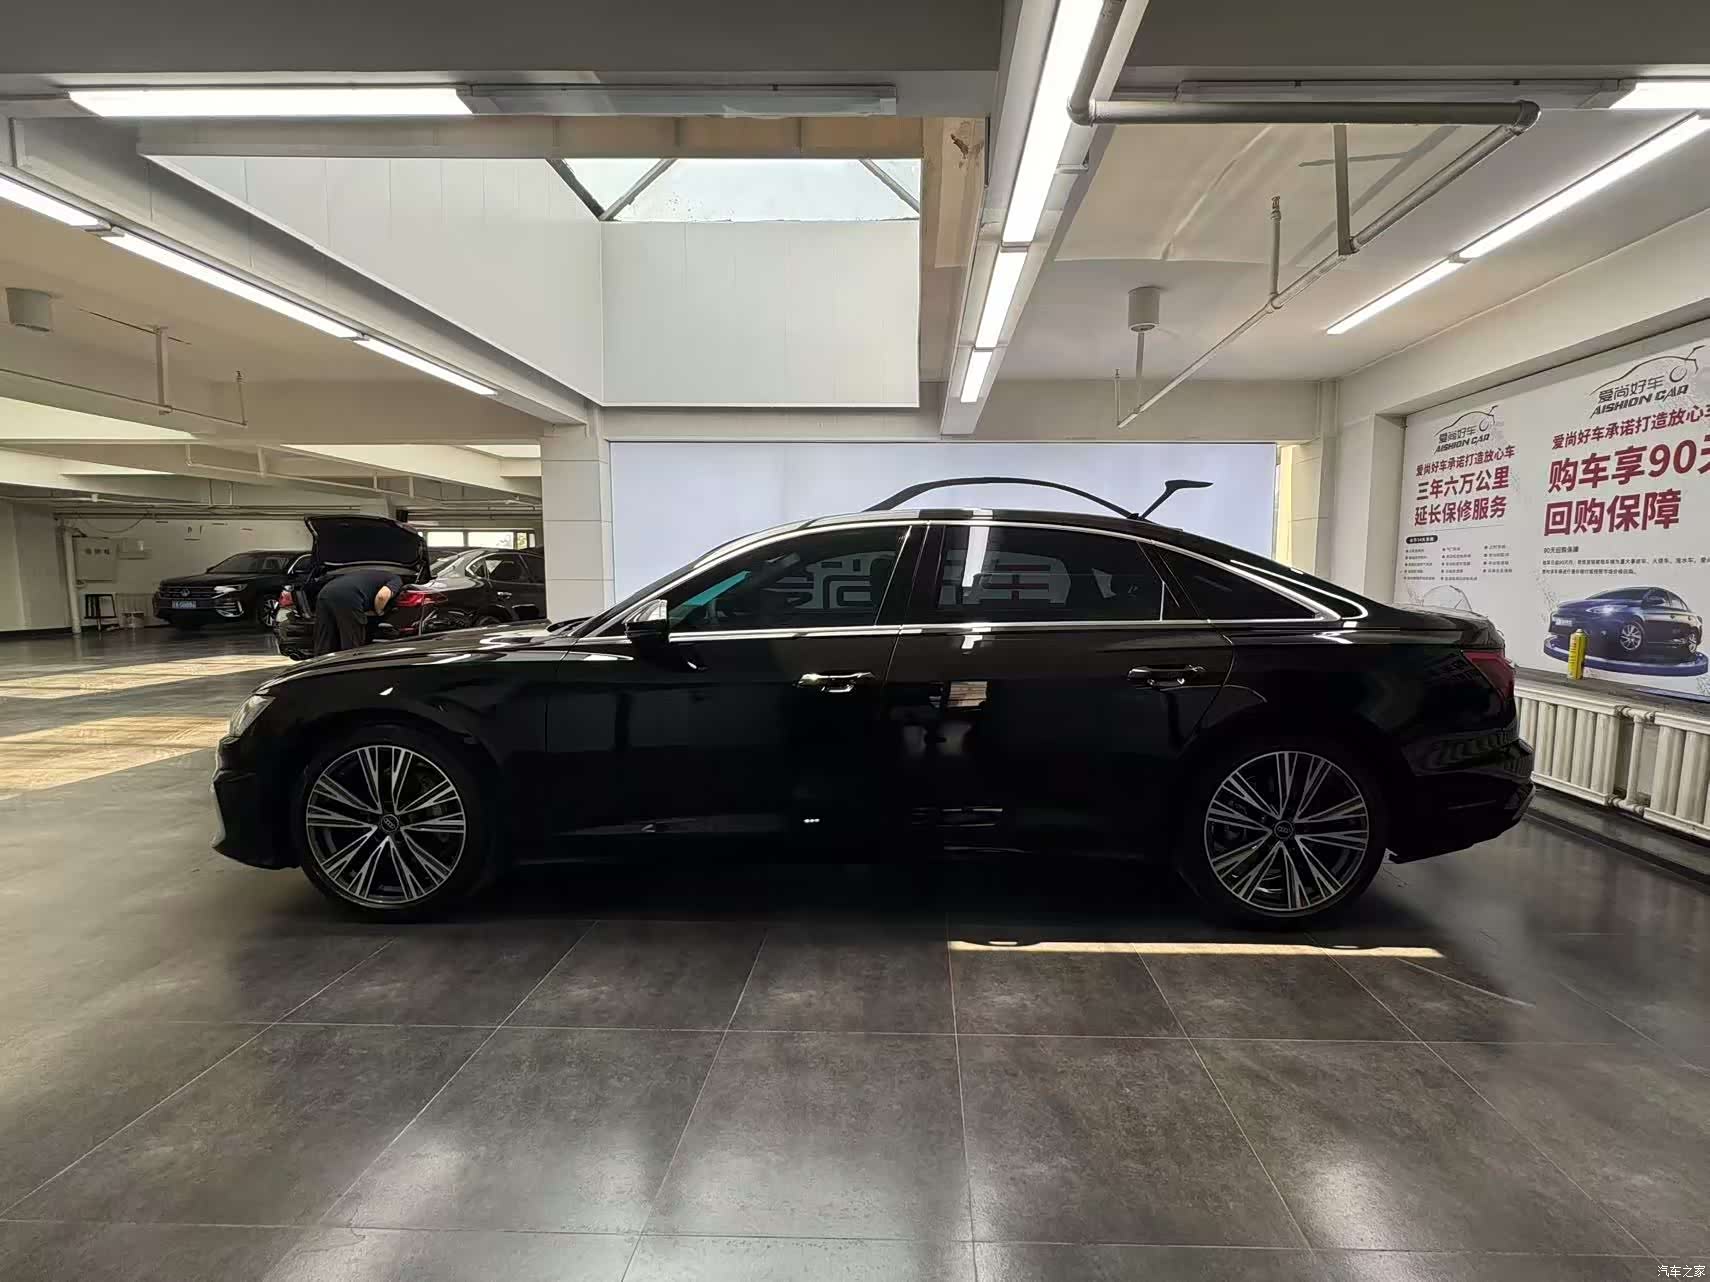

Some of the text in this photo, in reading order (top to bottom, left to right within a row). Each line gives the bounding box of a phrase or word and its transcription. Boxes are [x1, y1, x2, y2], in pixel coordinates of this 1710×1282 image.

[1590, 384, 1689, 419] AISHION CAR
[1598, 375, 1665, 404] 爱尚好车
[1434, 433, 1490, 455] AISHION CAR
[1438, 425, 1477, 444] 爱尚好车
[1416, 444, 1516, 476] 爱尚好车承诺打造放心车
[1416, 465, 1510, 501] 三年六万公里
[1414, 495, 1507, 526] 延长保修服务
[1544, 488, 1682, 536] 回购保障
